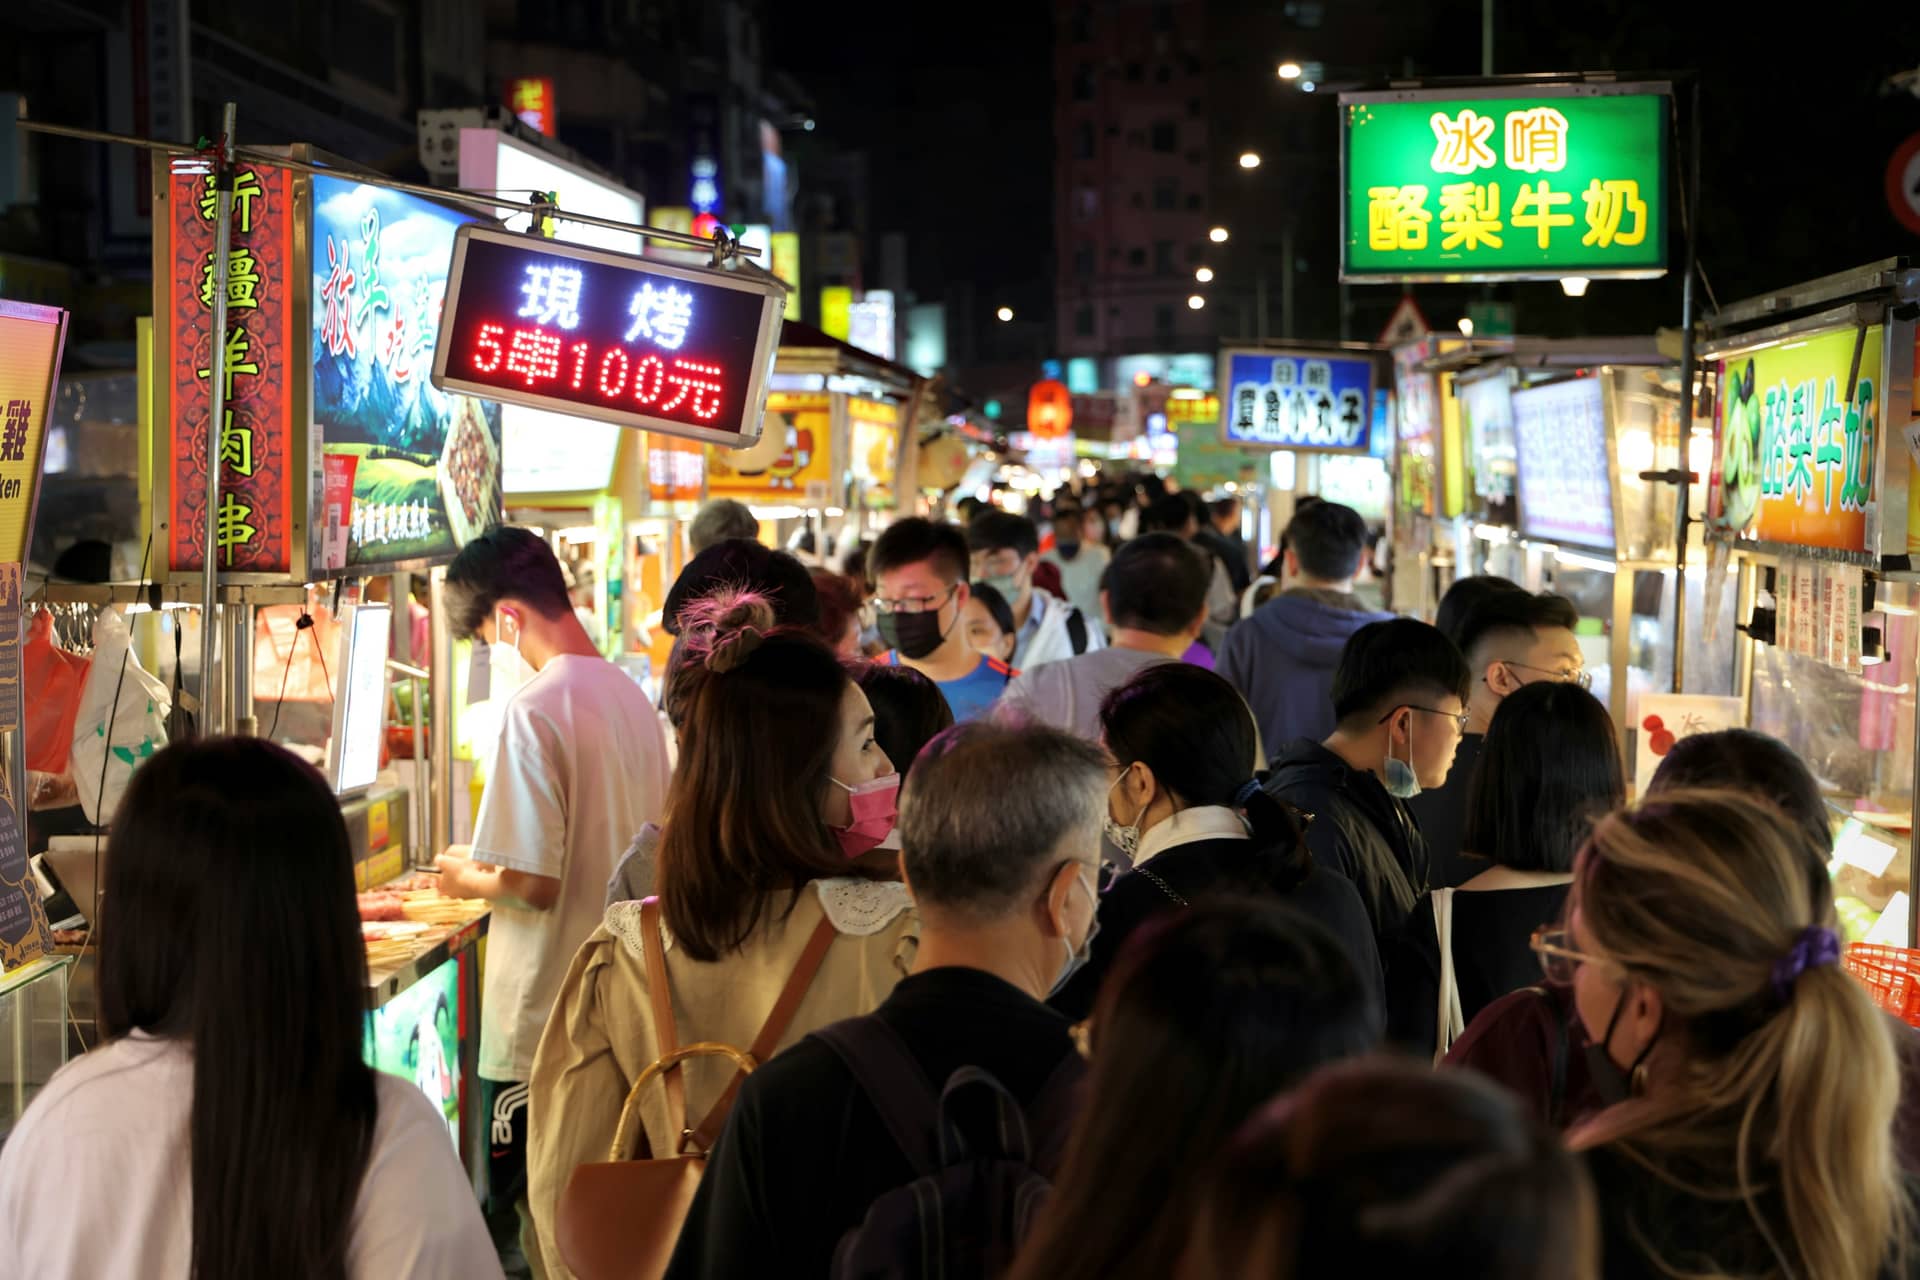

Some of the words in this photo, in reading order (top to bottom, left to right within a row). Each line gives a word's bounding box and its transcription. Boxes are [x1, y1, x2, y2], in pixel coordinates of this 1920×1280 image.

[1430, 107, 1568, 174] 冰哨
[1368, 179, 1647, 250] 酪梨牛奶
[322, 207, 447, 383] 放羊吃草
[199, 171, 263, 567] 新疆羊肉串
[473, 323, 721, 419] 5串100元
[0, 399, 31, 461] 雞
[1761, 377, 1873, 513] 酪梨牛奶
